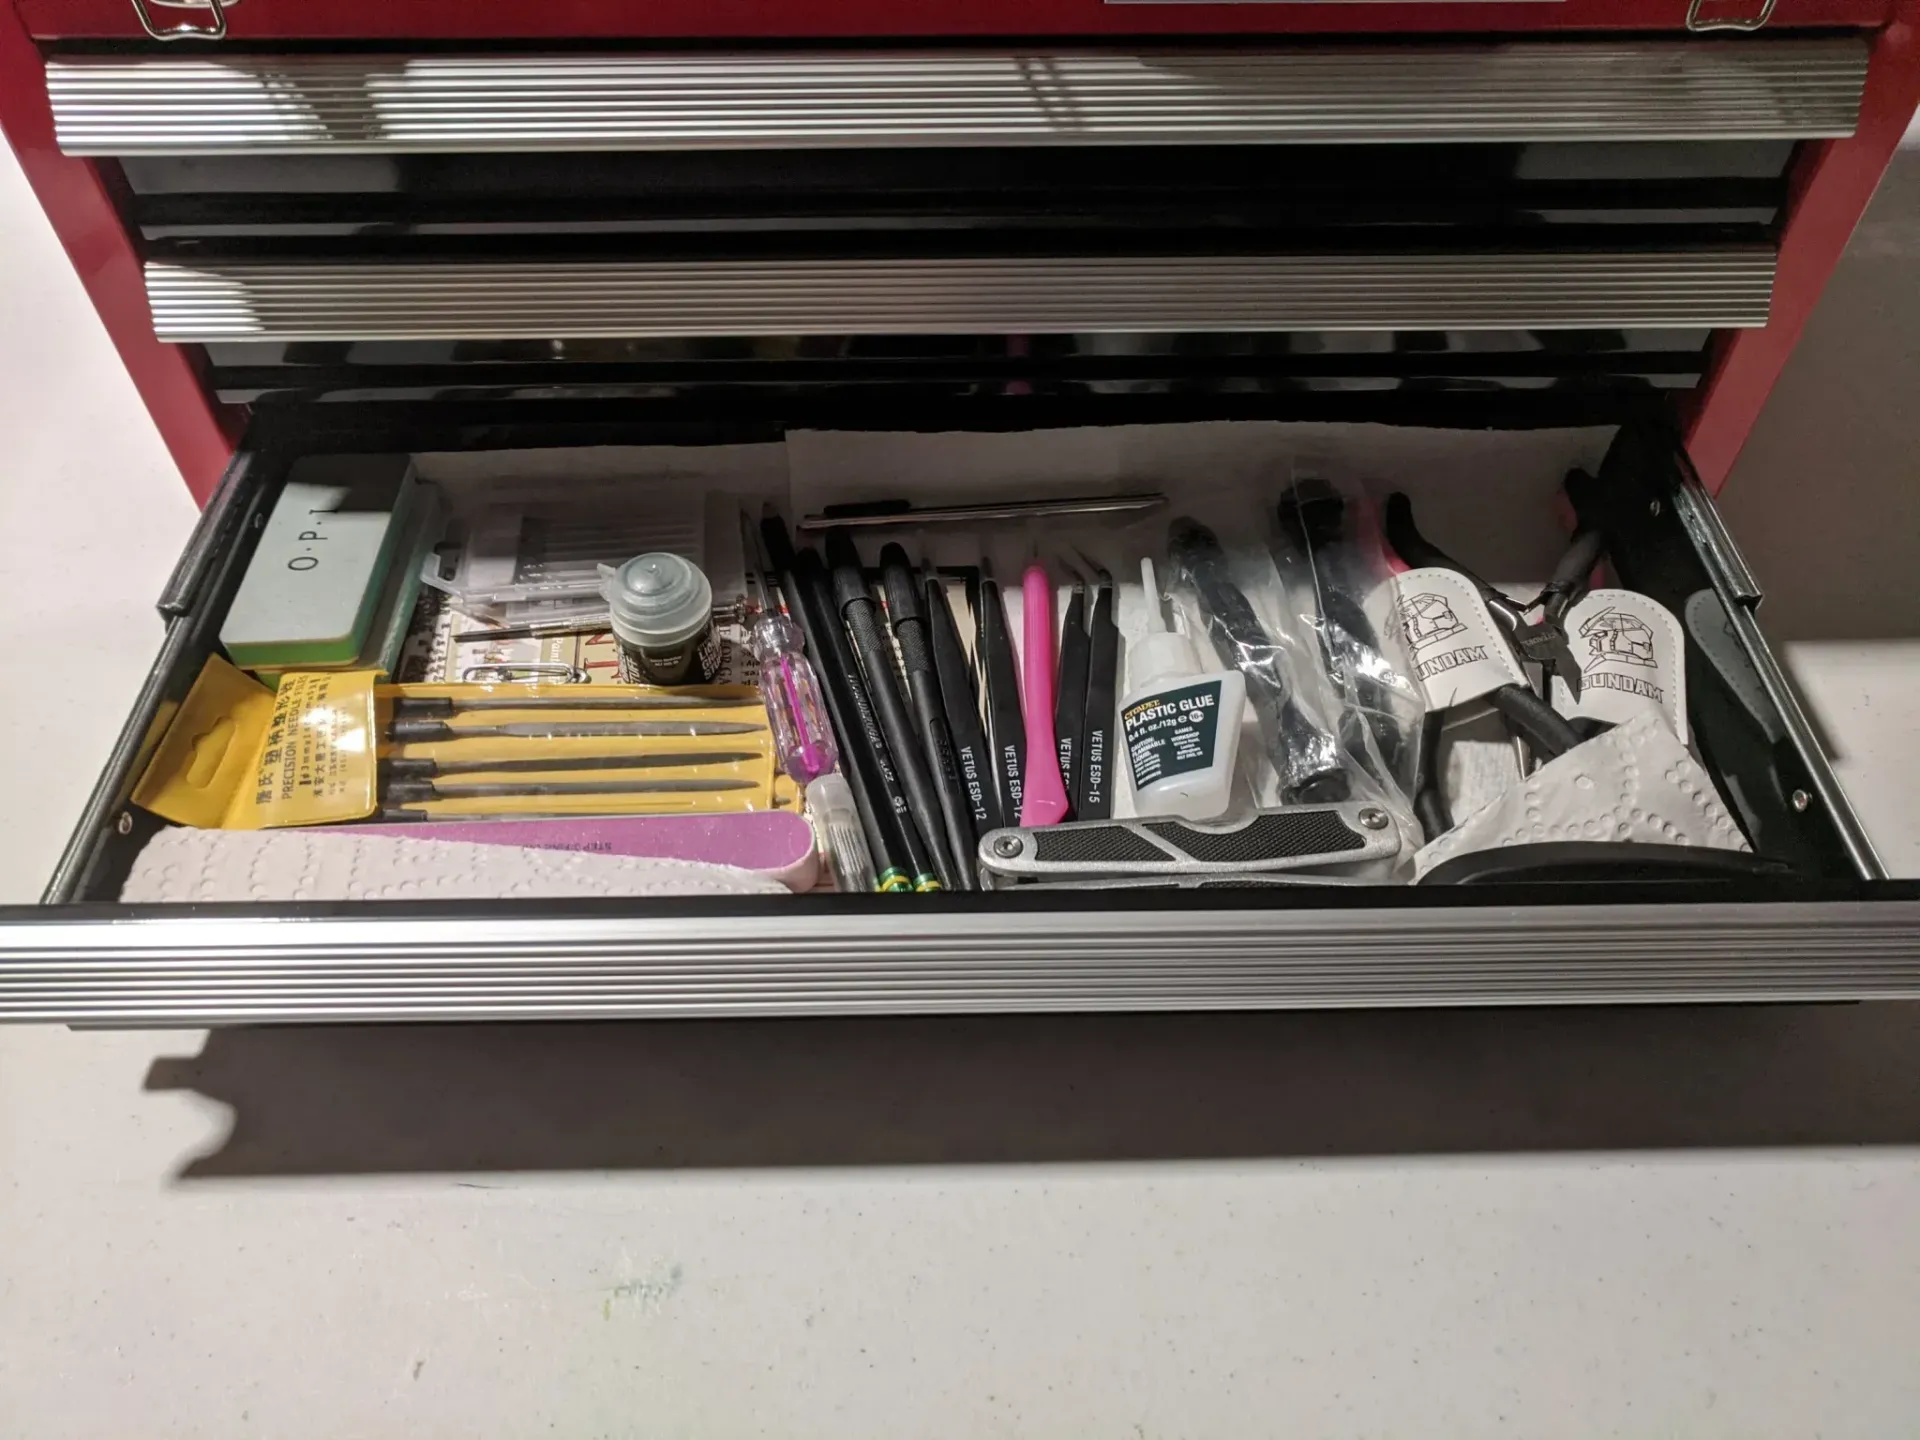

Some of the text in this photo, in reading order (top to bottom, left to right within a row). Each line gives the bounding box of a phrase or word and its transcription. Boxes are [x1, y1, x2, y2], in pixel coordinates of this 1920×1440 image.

[1415, 645, 1489, 682] UNDAM
[1576, 672, 1664, 704] GUNDAM
[287, 699, 302, 736] NEEDLE
[1125, 694, 1215, 732] PLASTIC GLUE
[1004, 744, 1019, 778] VETUS
[1060, 737, 1073, 770] VETUS
[1088, 730, 1104, 804] VETUS ESD-15
[1132, 739, 1166, 758] FLAMMABLE
[281, 741, 297, 800] PRECISION
[960, 745, 988, 821] VETUS ESD-12
